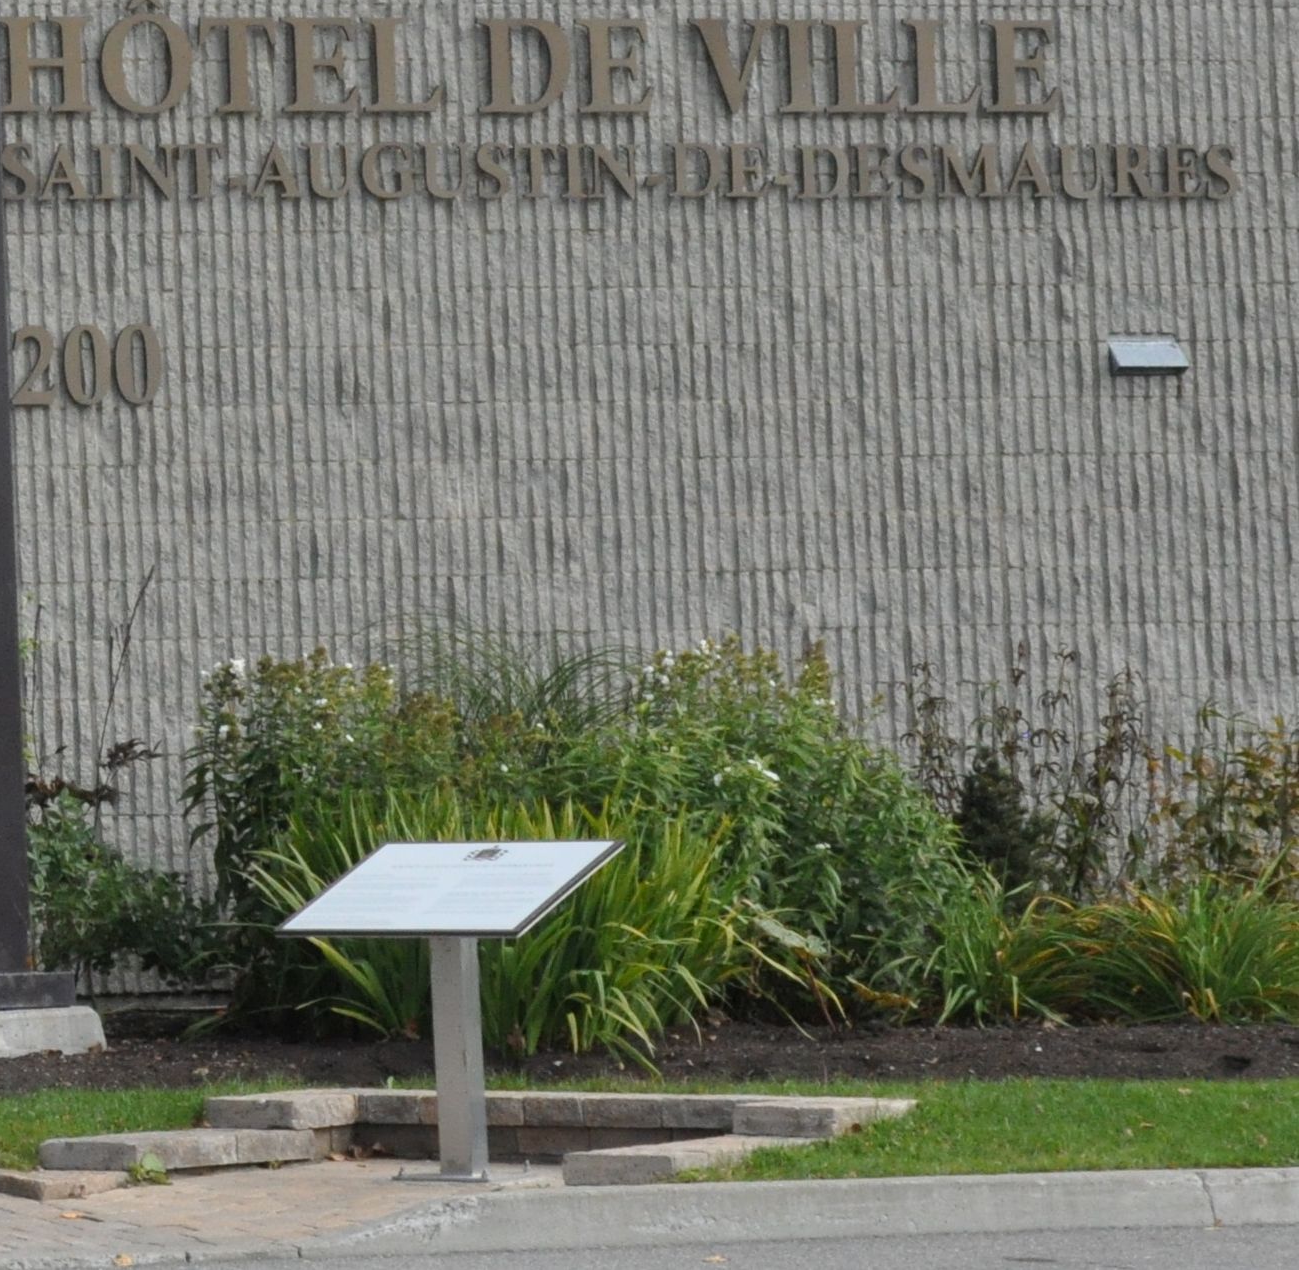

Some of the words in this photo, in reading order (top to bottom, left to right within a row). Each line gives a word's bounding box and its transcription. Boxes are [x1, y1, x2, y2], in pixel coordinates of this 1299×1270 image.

[480, 16, 654, 115] DE
[689, 18, 1063, 115] VILLE
[10, 324, 163, 407] 200
